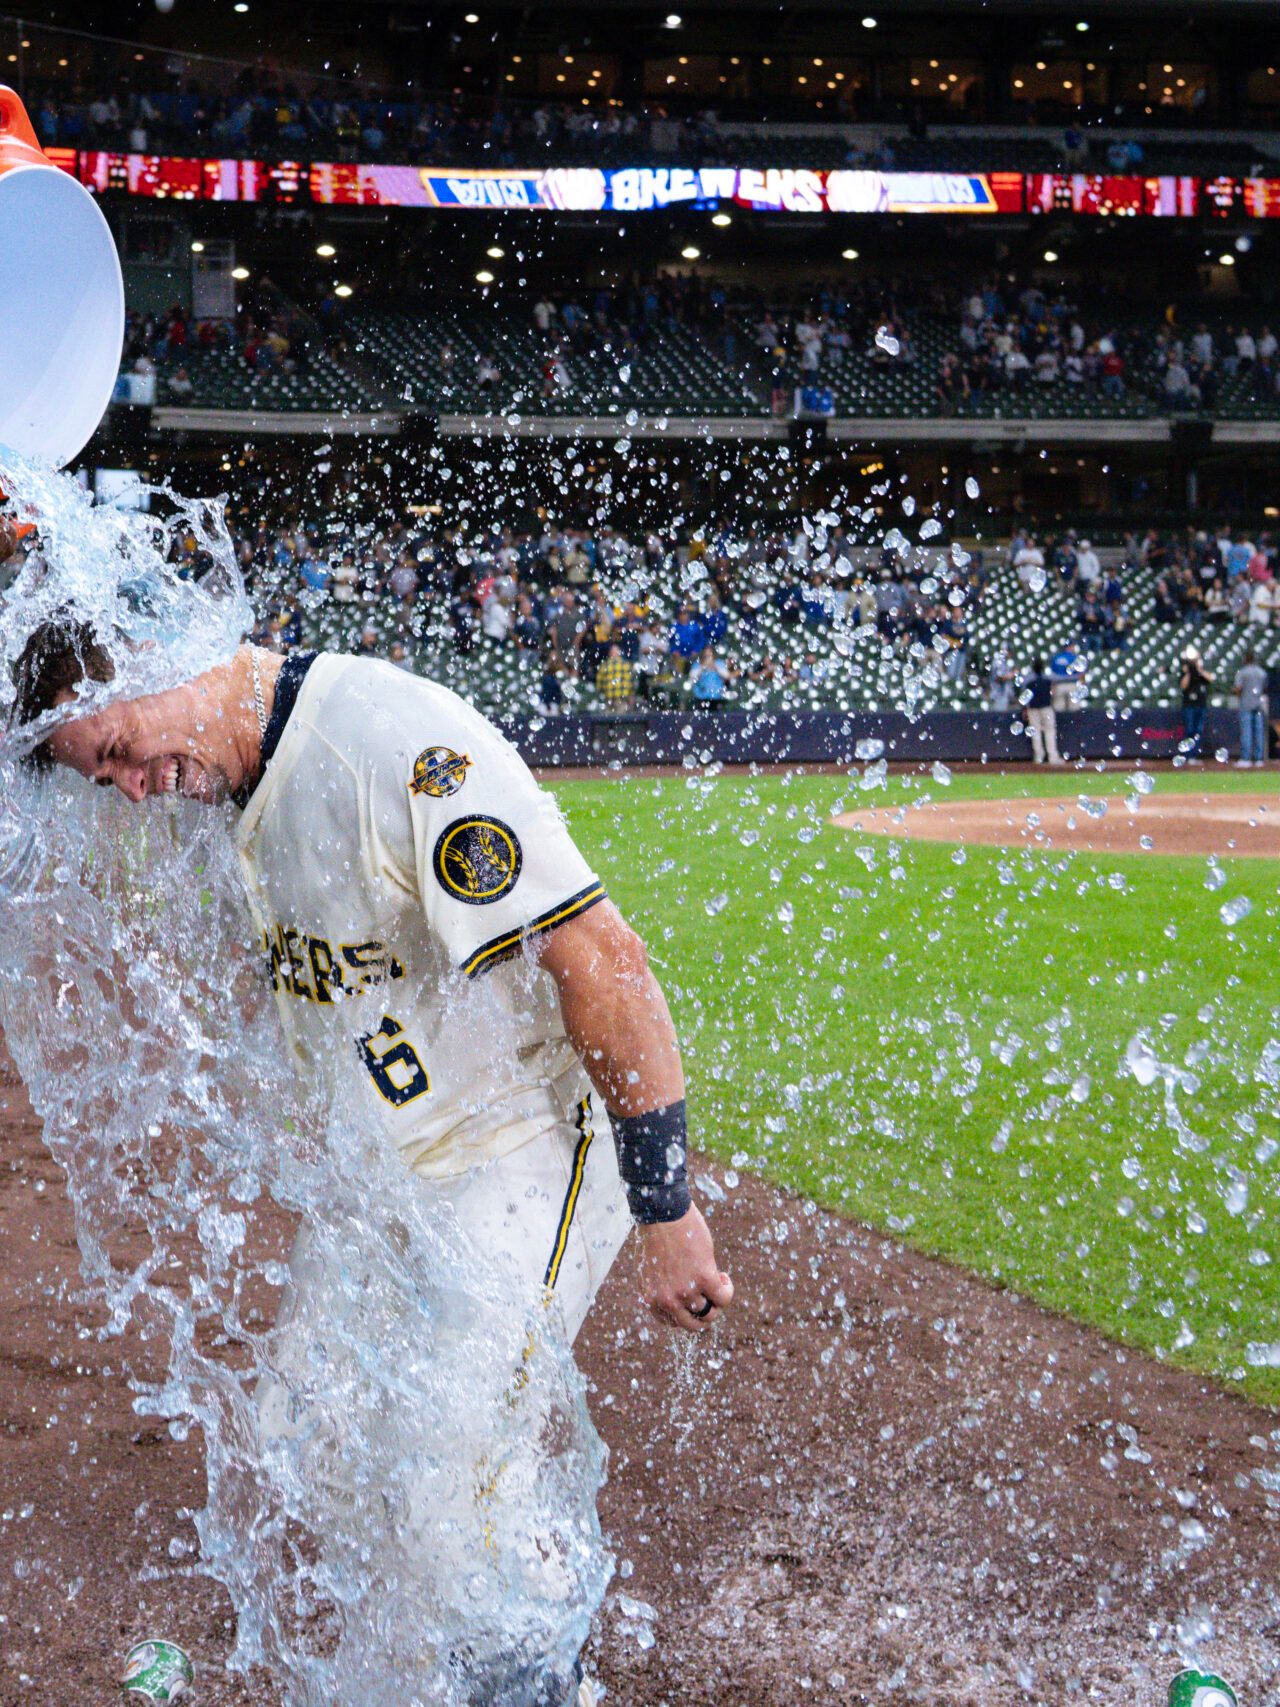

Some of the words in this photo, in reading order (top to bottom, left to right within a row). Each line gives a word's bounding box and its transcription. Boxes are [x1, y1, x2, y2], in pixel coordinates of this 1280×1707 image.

[447, 179, 530, 206] WIN
[610, 167, 824, 212] BREWERS
[354, 1012, 432, 1111] 6
